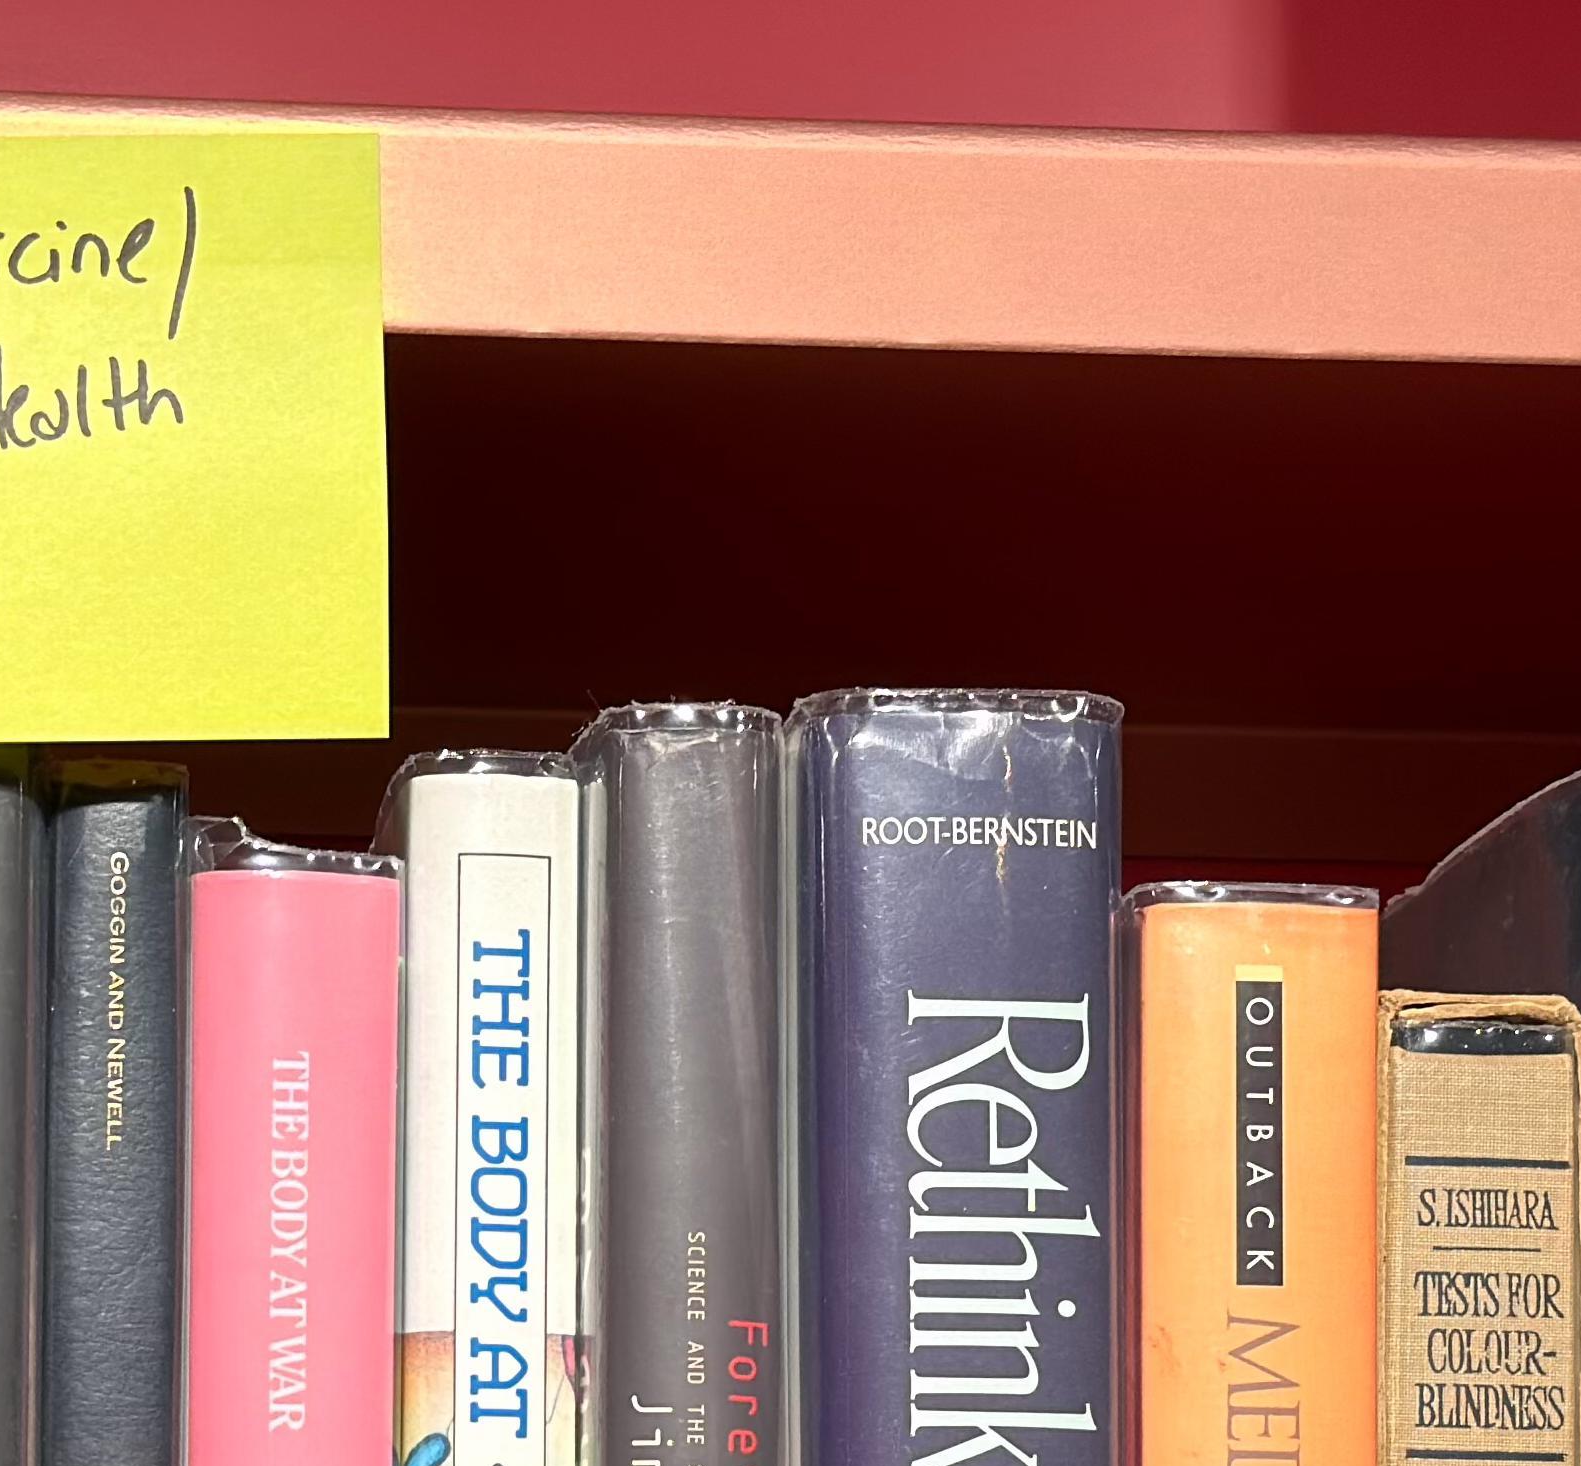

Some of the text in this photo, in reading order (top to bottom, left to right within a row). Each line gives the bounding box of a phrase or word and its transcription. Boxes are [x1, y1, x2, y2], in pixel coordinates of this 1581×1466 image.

[862, 816, 1097, 849] ROOT-BERNSTEIN
[105, 851, 129, 1152] GOGGIN AND NEWELL
[1245, 997, 1275, 1270] OUTBACK
[469, 929, 531, 1437] THE BODY AT
[267, 1051, 310, 1434] THE BODY AT WAR
[687, 1231, 705, 1321] SCIENCE
[1414, 1273, 1564, 1319] TESTS FOR
[687, 1342, 705, 1384] AND
[1428, 1329, 1556, 1375] COLOUR-
[686, 1405, 705, 1445] THE
[1414, 1383, 1565, 1431] BLINDNESS
